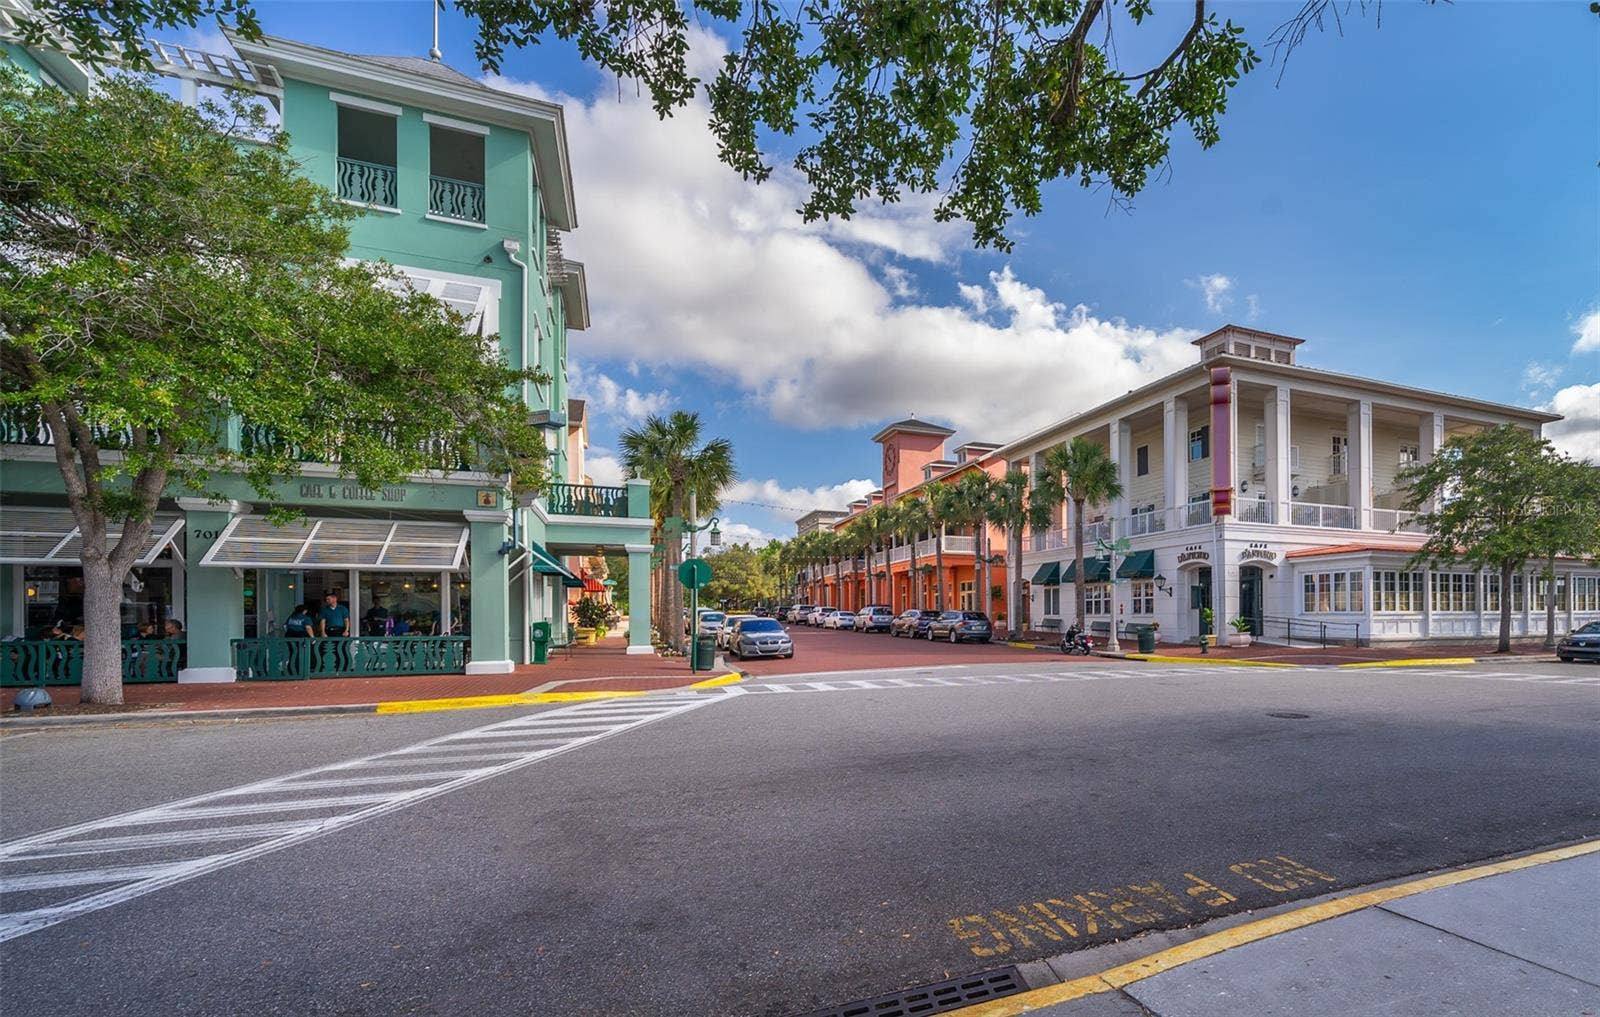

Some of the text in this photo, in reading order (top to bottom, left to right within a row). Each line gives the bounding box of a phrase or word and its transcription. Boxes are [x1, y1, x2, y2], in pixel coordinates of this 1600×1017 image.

[382, 486, 406, 502] SHOP
[194, 529, 218, 539] 701
[946, 856, 1336, 957] NO PARKING
